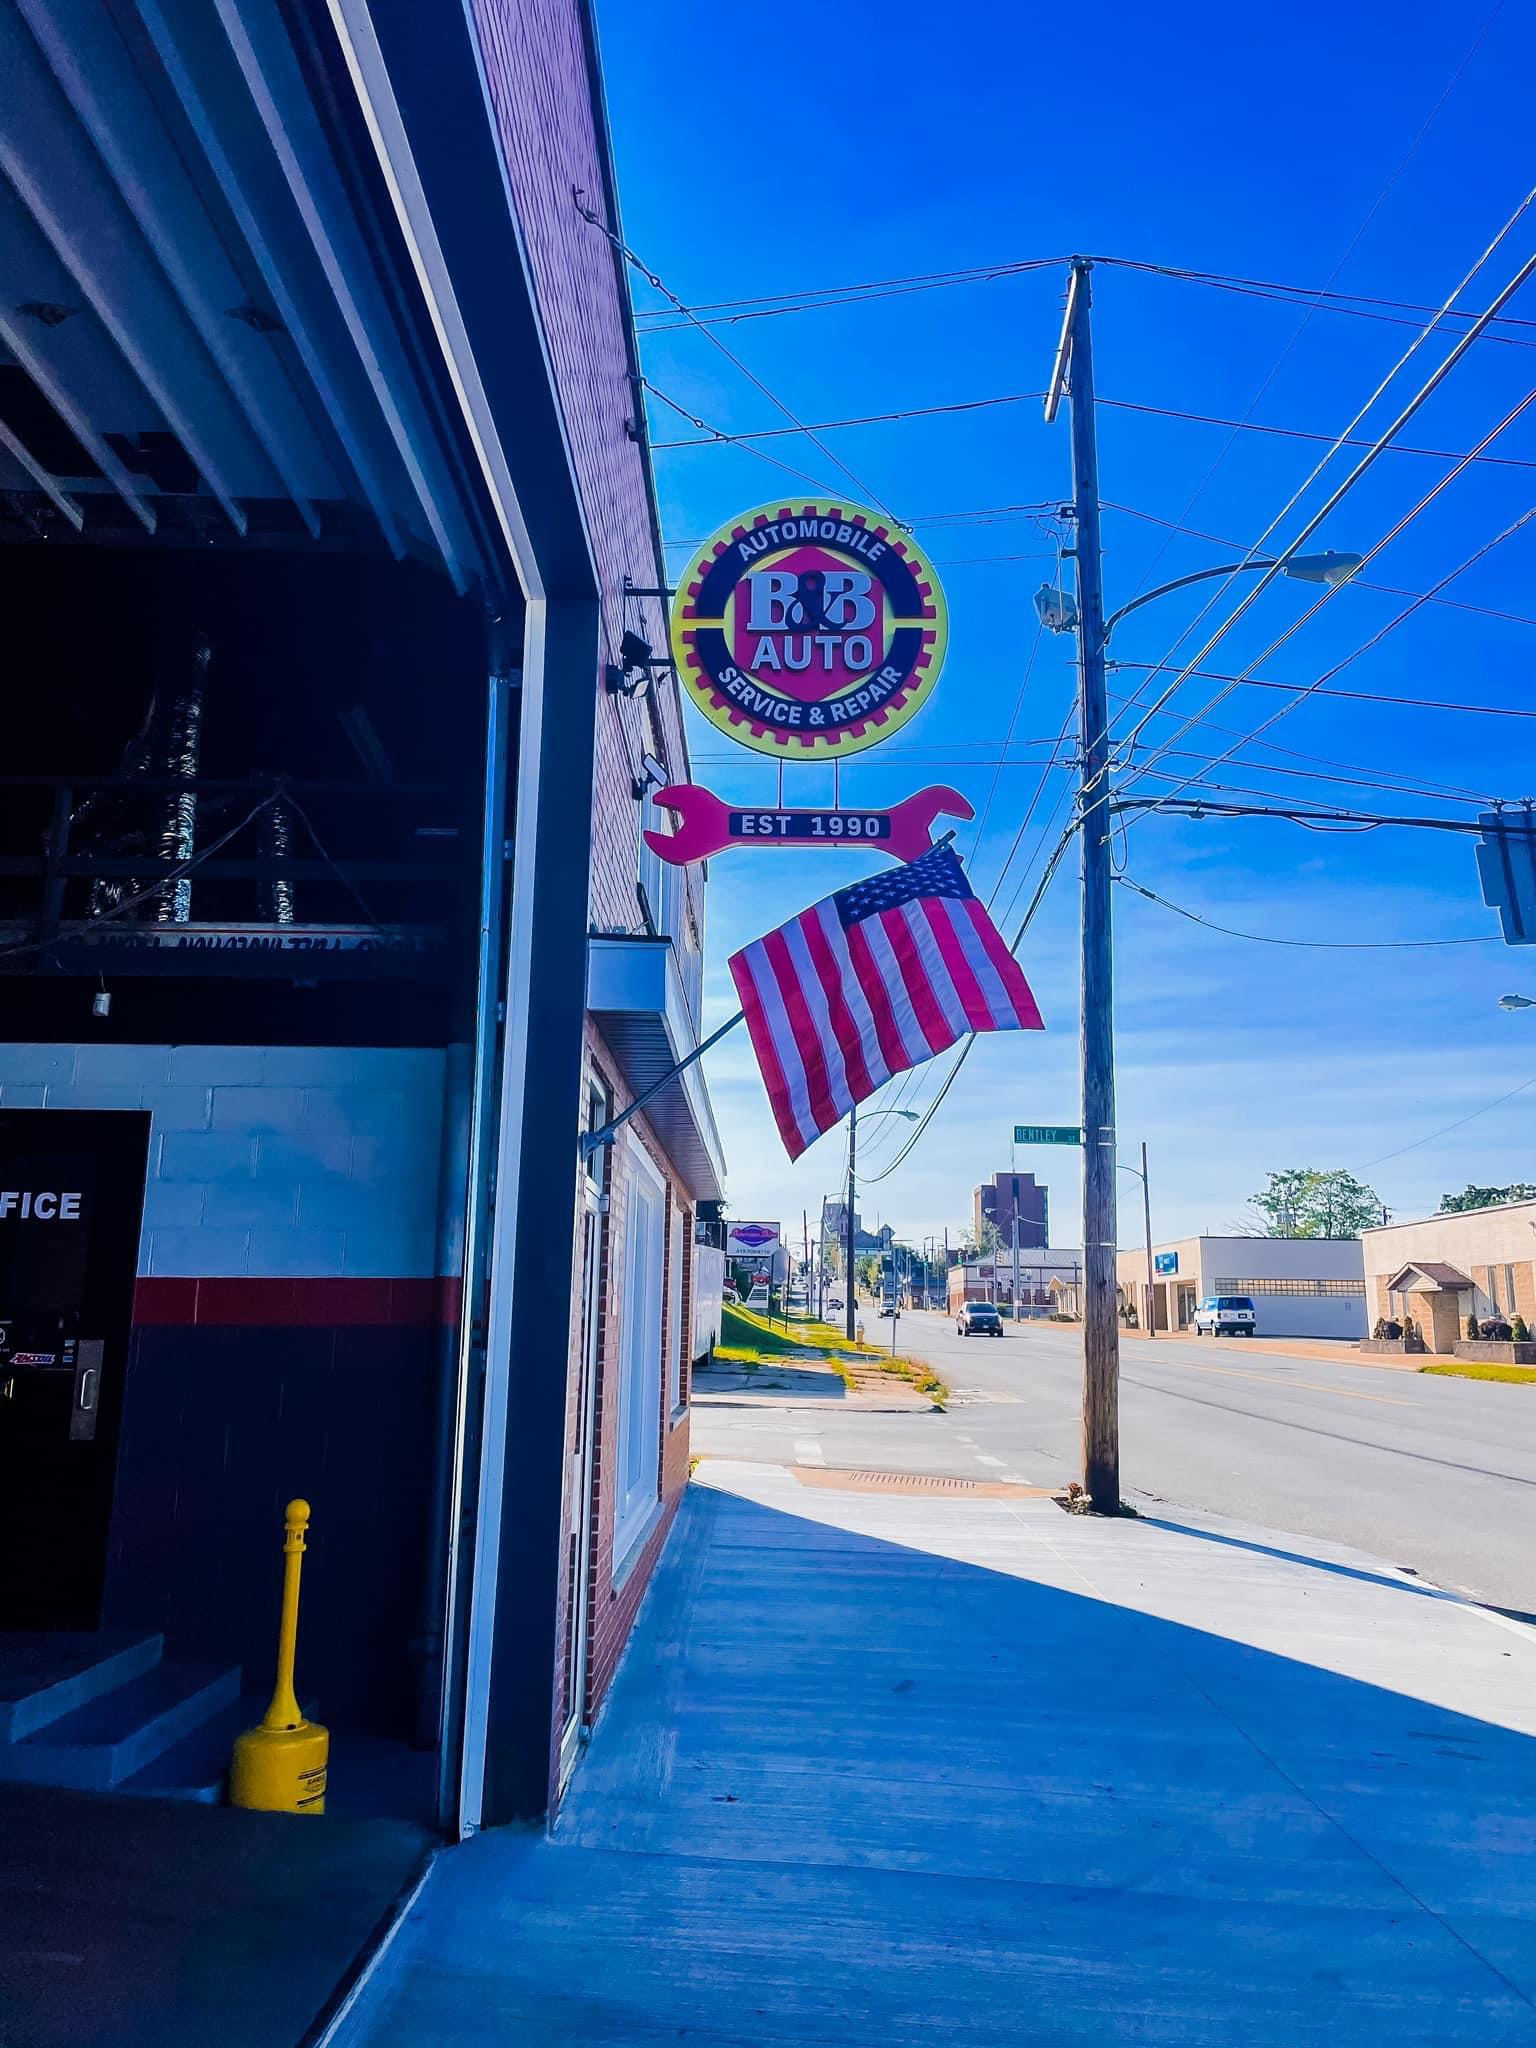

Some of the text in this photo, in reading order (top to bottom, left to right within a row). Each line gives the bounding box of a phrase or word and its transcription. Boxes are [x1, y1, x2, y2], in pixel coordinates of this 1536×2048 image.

[738, 520, 887, 562] AUTOMOBILE
[747, 570, 877, 632] B&B
[751, 635, 873, 671] AUTO
[718, 664, 903, 725] SERVICE & REPAIR
[741, 815, 880, 837] EST 1990
[1015, 1128, 1057, 1142] BENTLEY
